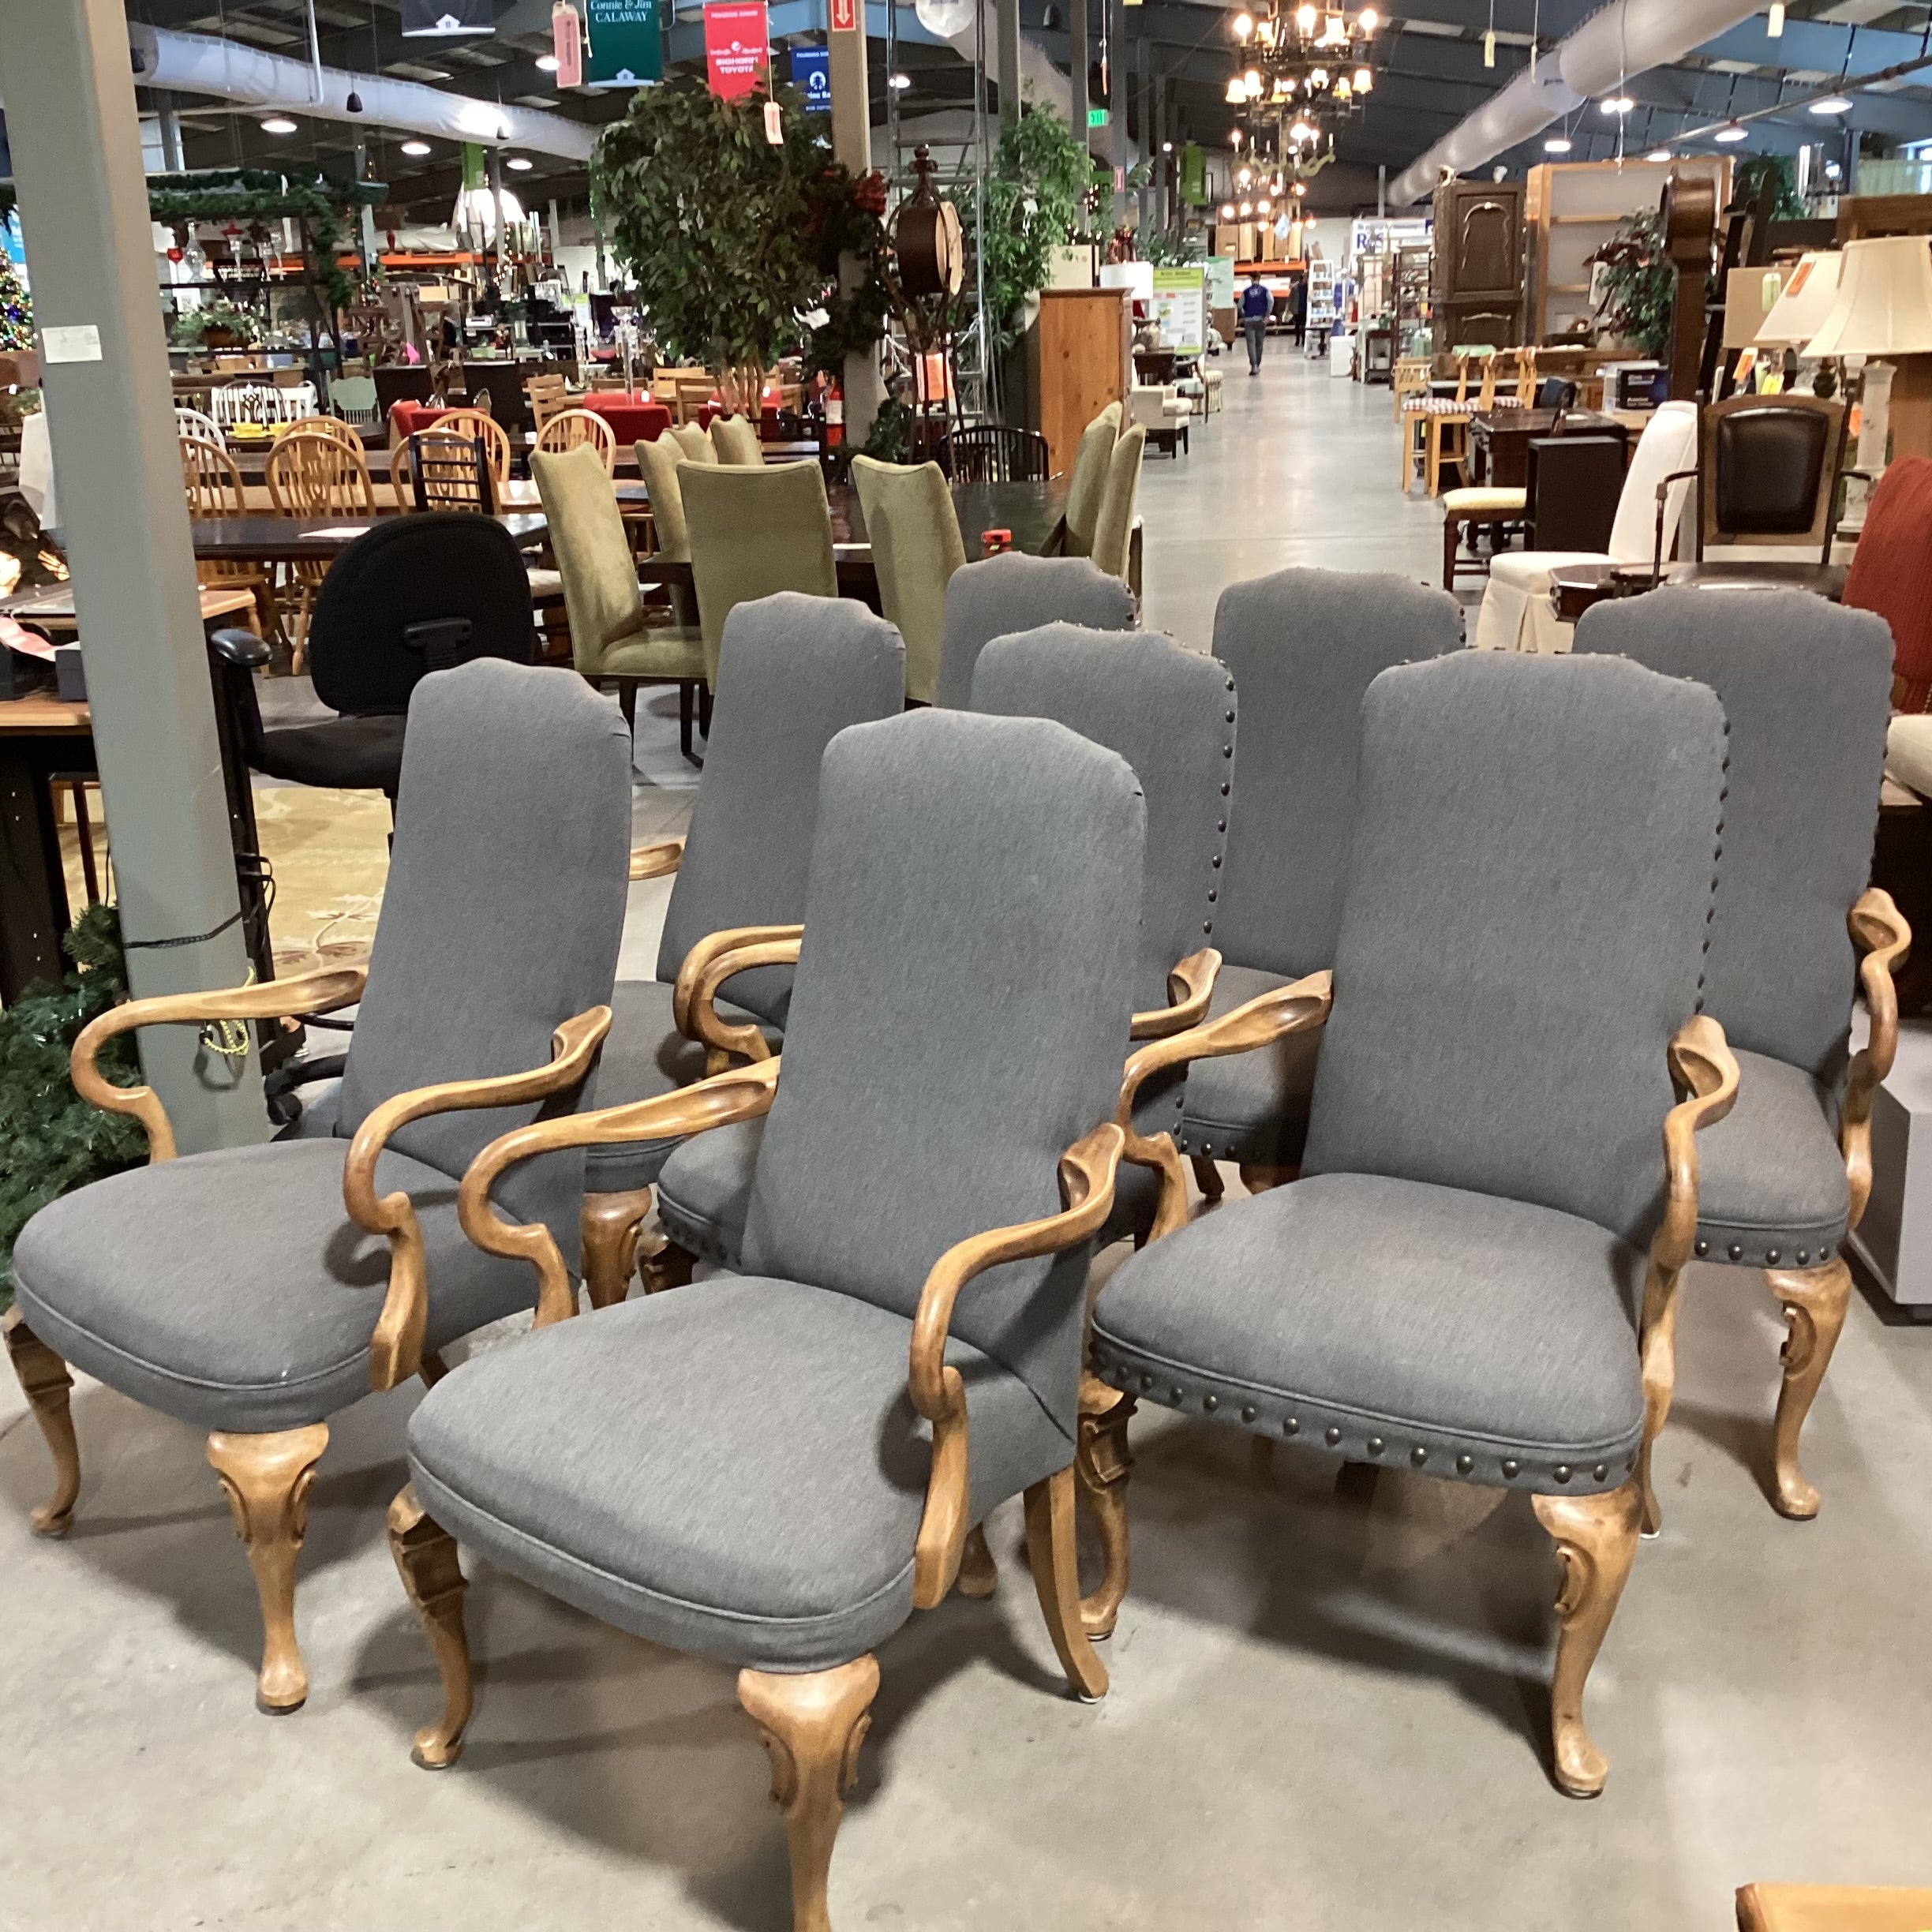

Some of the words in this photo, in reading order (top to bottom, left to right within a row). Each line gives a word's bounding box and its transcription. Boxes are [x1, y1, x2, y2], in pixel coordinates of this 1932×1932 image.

[590, 1, 623, 10] Connie
[635, 0, 653, 9] Jim
[595, 11, 647, 23] CALAWAY
